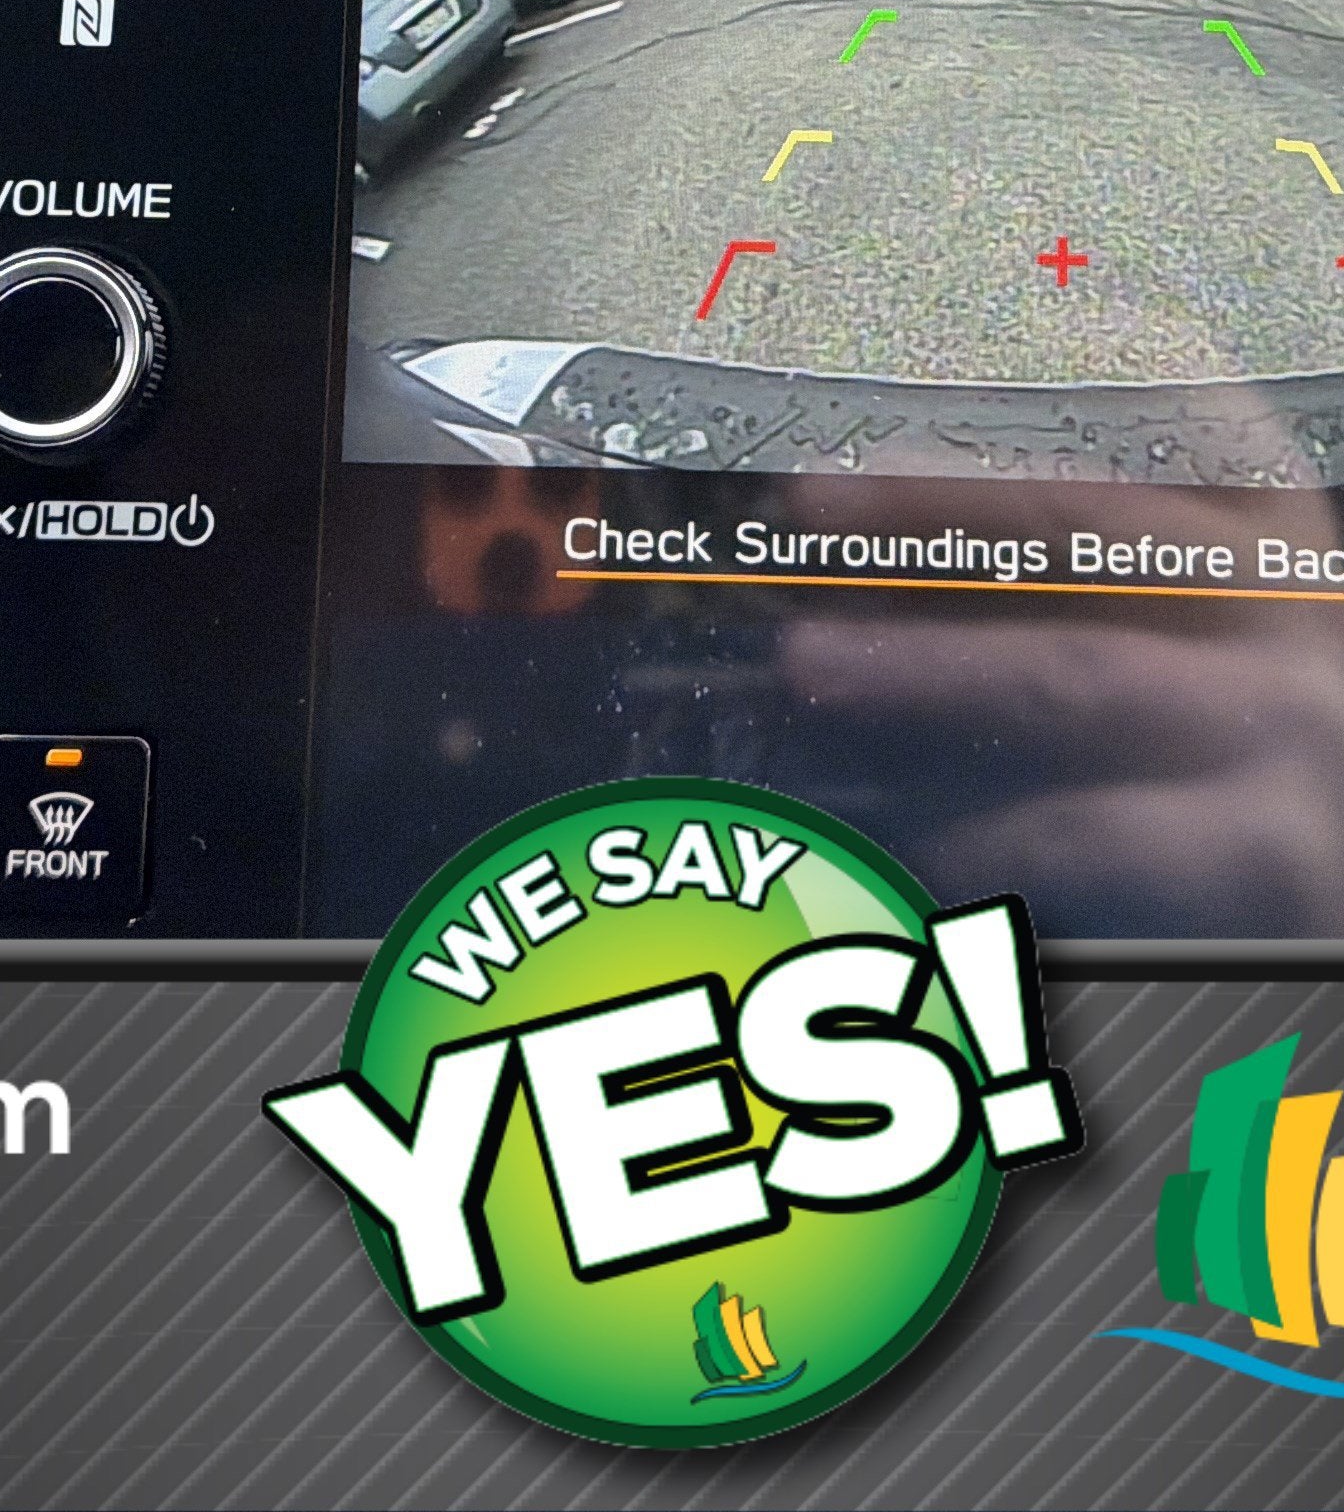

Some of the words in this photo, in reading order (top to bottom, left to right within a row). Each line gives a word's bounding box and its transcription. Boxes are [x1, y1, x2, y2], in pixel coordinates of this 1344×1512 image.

[563, 517, 713, 563] Check
[735, 523, 1048, 582] Surroundings
[1069, 531, 1235, 578] Before
[4, 849, 110, 880] FRONT
